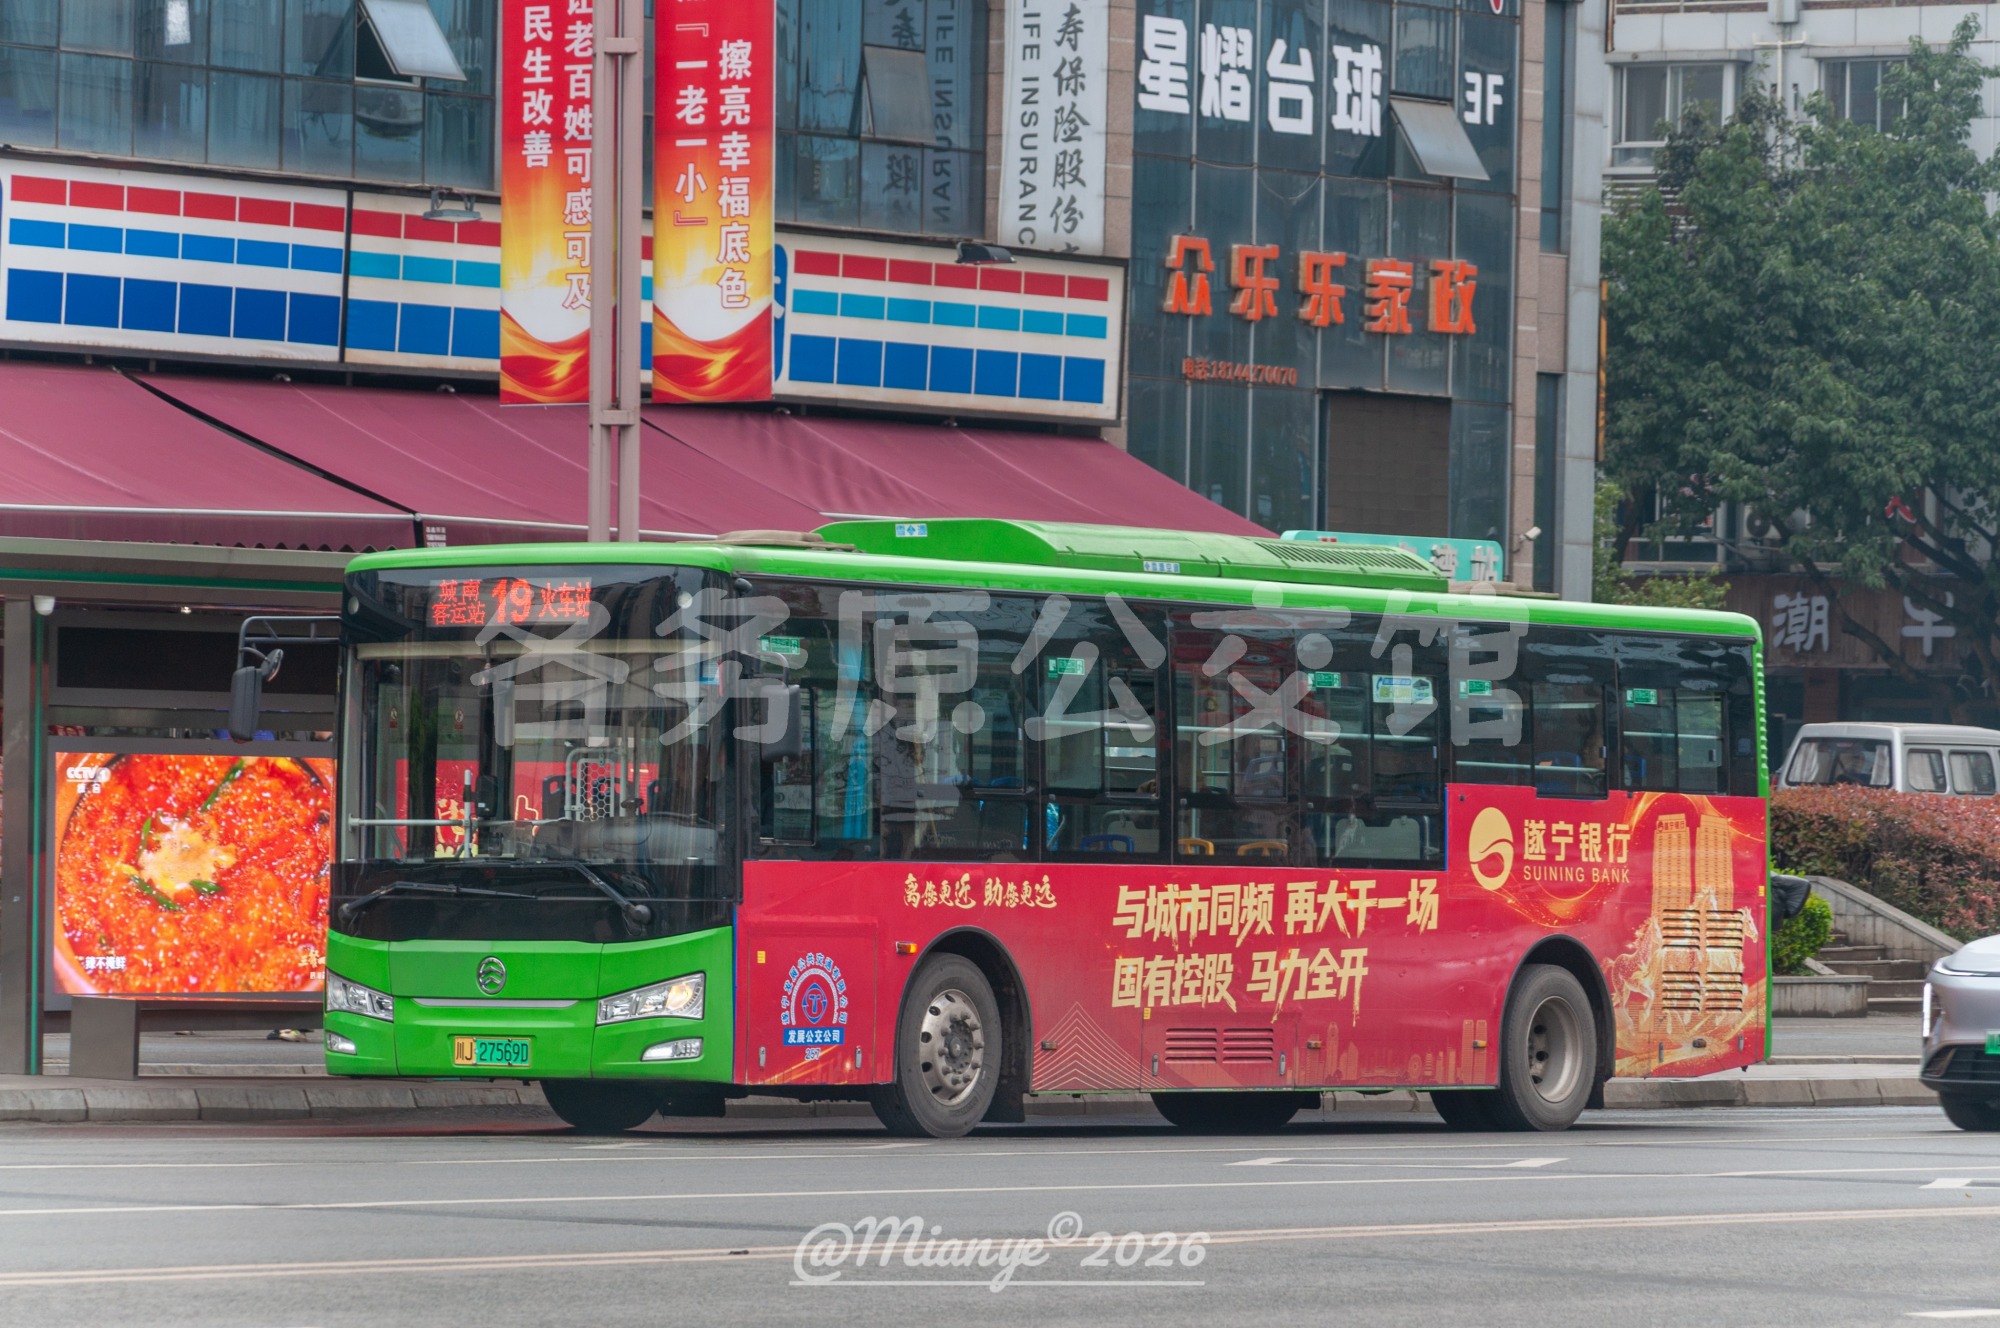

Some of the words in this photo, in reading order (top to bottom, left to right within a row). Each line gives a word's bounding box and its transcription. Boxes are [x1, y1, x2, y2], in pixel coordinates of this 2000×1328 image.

[521, 5, 554, 169] 民生改善
[1138, 15, 1383, 137] 星熠台球
[673, 0, 709, 227] 『一老一小』
[1049, 2, 1091, 254] 寿保险股份
[717, 39, 752, 310] 擦亮幸福底色
[1162, 234, 1478, 335] 众乐乐家政
[431, 601, 486, 625] 客运站
[439, 579, 482, 603] 城南
[491, 578, 535, 624] 19
[538, 580, 592, 618] 火车站
[1524, 818, 1631, 864] 遂宁银行
[1523, 864, 1585, 882] SUINING
[1591, 867, 1630, 884] BANK
[1112, 883, 1275, 951] 与城市同频
[1284, 878, 1440, 940] 再大干一场
[1111, 952, 1237, 1012] 国有控股
[1246, 947, 1369, 1028] 马力全开
[786, 1029, 841, 1043] 发展公交公司
[804, 1047, 821, 1060] 257
